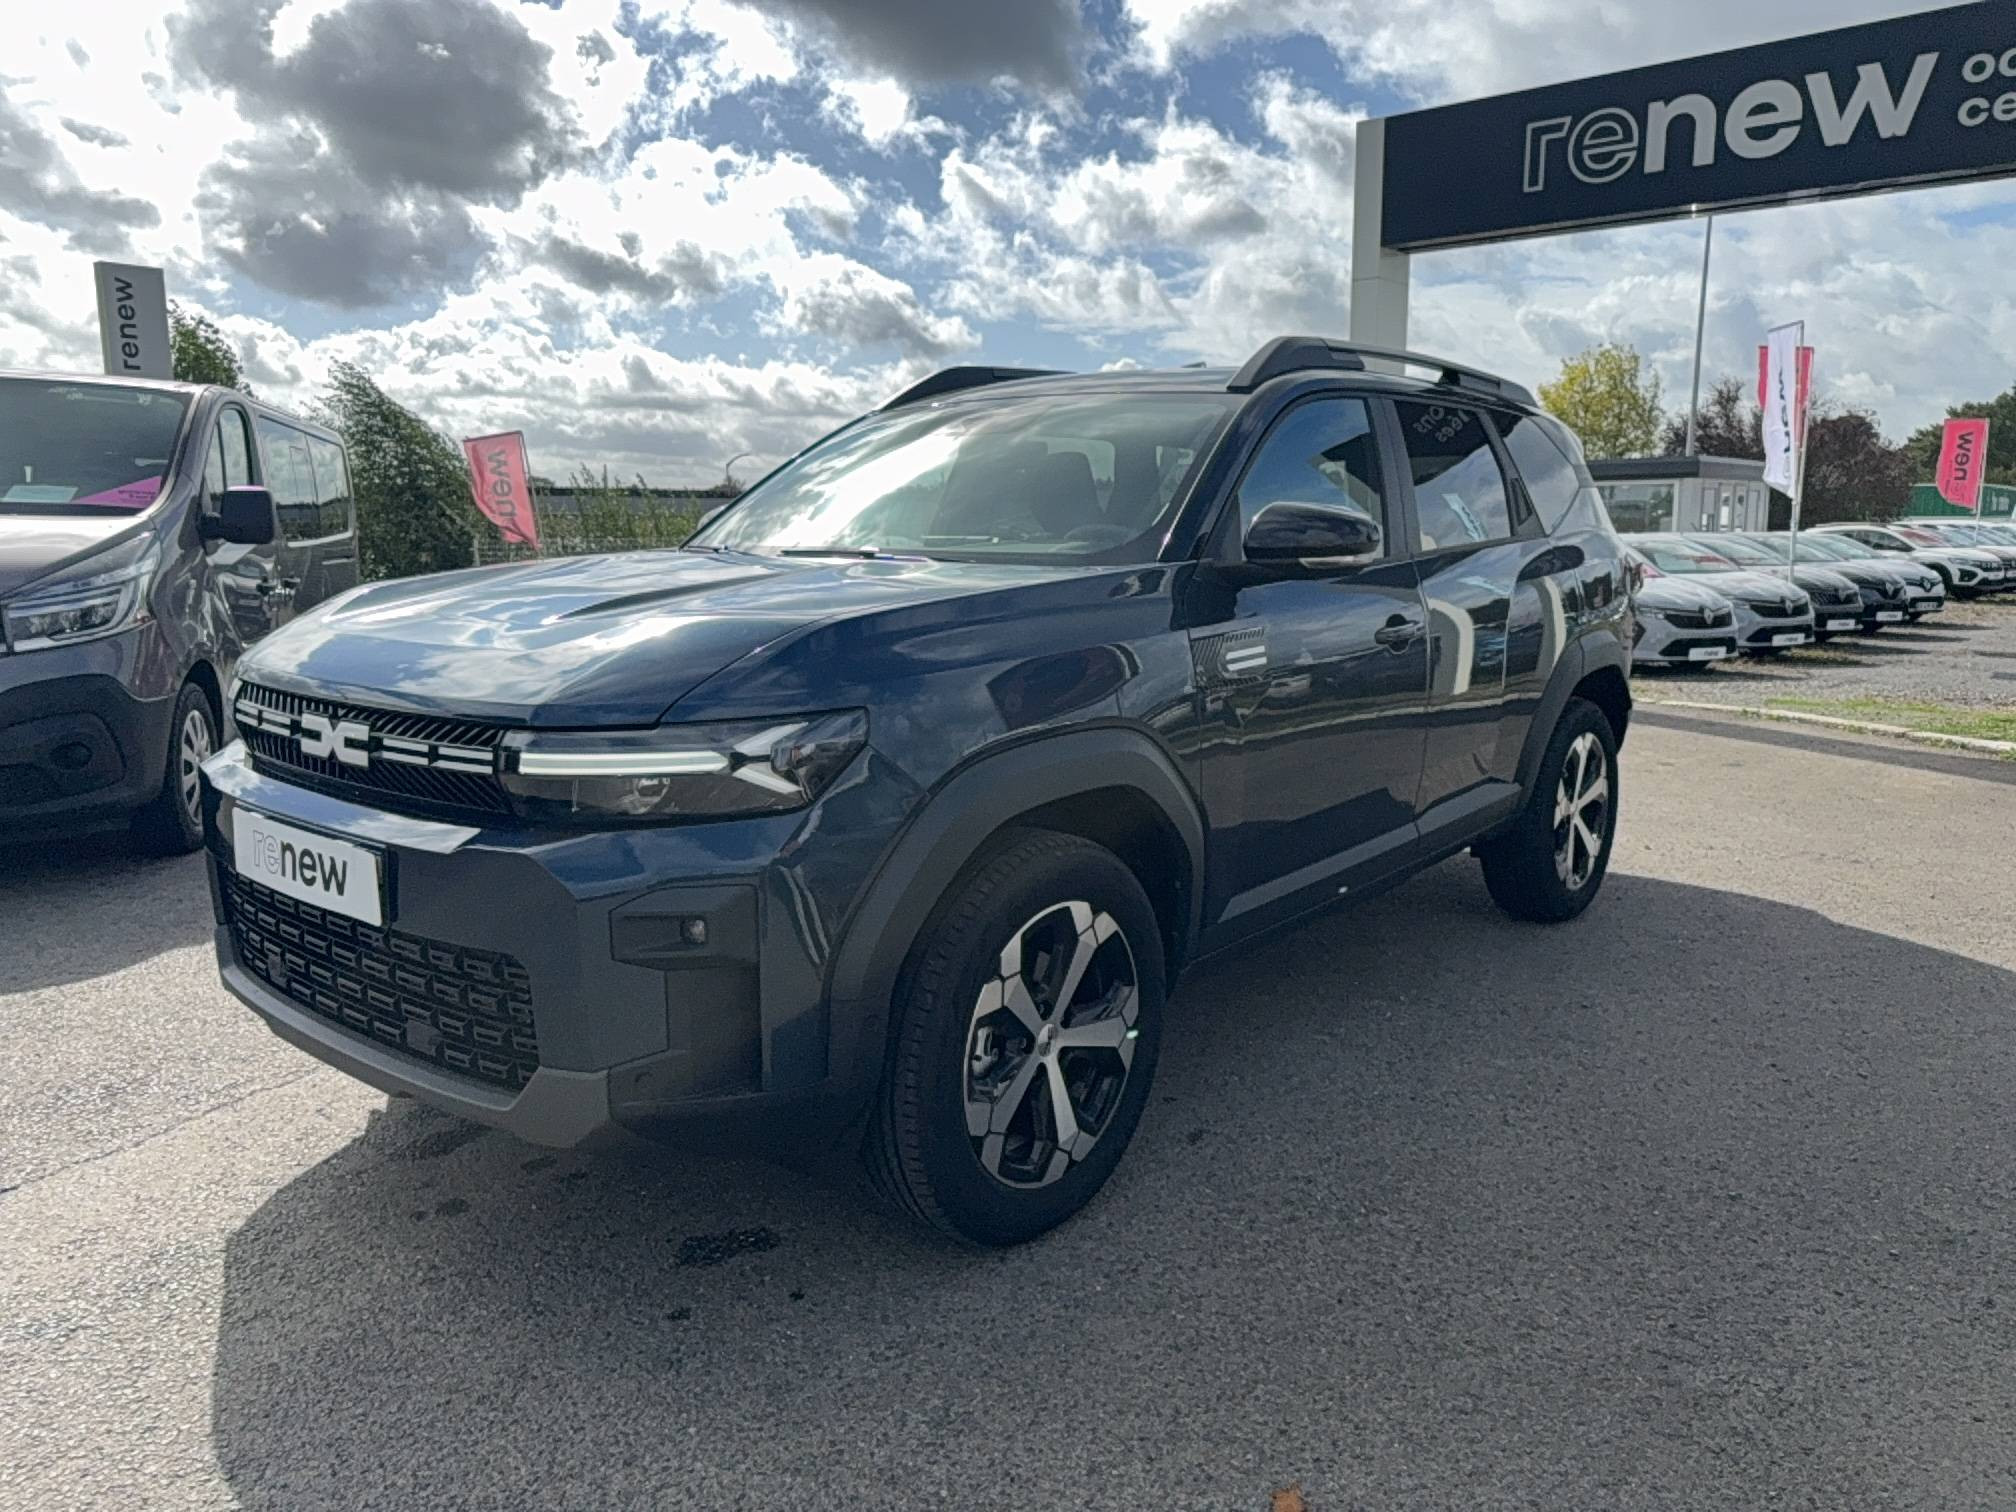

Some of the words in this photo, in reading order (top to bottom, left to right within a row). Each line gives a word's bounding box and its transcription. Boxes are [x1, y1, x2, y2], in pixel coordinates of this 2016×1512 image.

[1522, 51, 1940, 193] renew
[1957, 91, 2016, 127] ce
[114, 276, 141, 371] renew
[252, 829, 348, 897] renew
